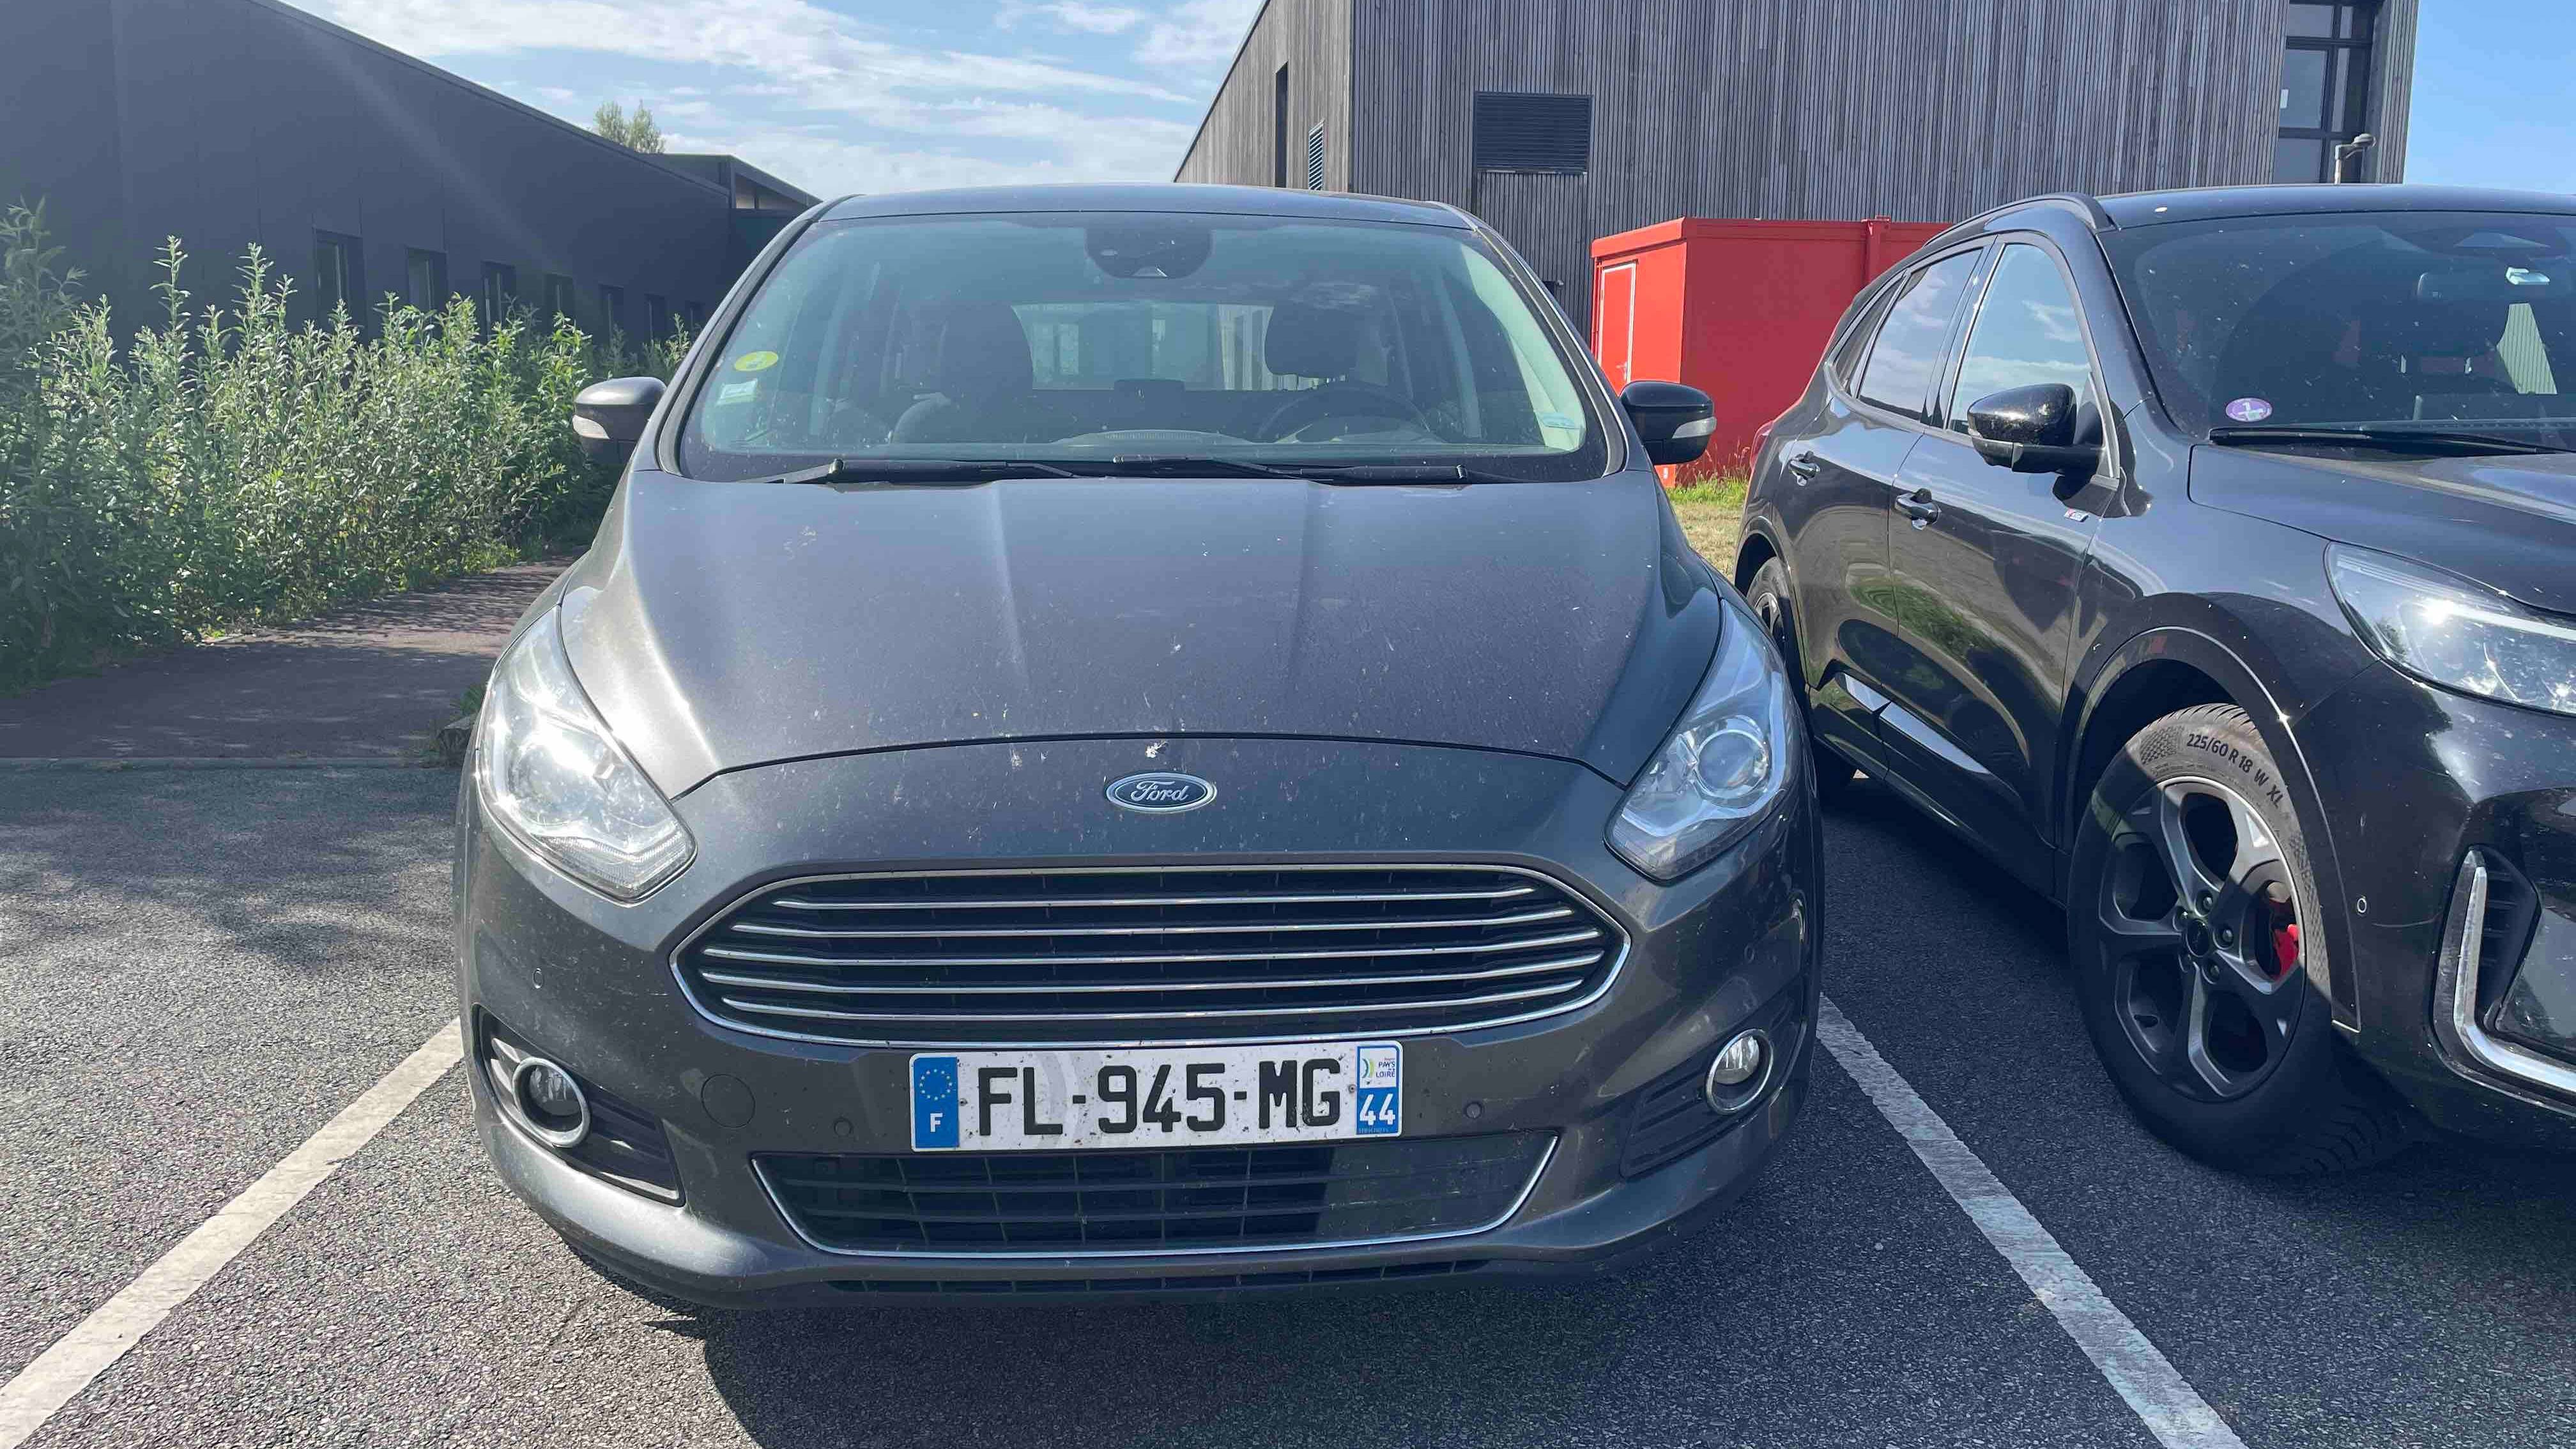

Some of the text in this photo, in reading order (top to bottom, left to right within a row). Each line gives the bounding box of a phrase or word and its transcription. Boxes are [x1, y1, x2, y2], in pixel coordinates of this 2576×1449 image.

[2187, 733, 2228, 757] 225/60
[2254, 768, 2269, 787] W
[2266, 785, 2283, 809] XL
[1130, 780, 1190, 801] Ford
[978, 1059, 1340, 1136] FL-945-MG
[1360, 1093, 1396, 1126] 44
[930, 1112, 943, 1133] F
